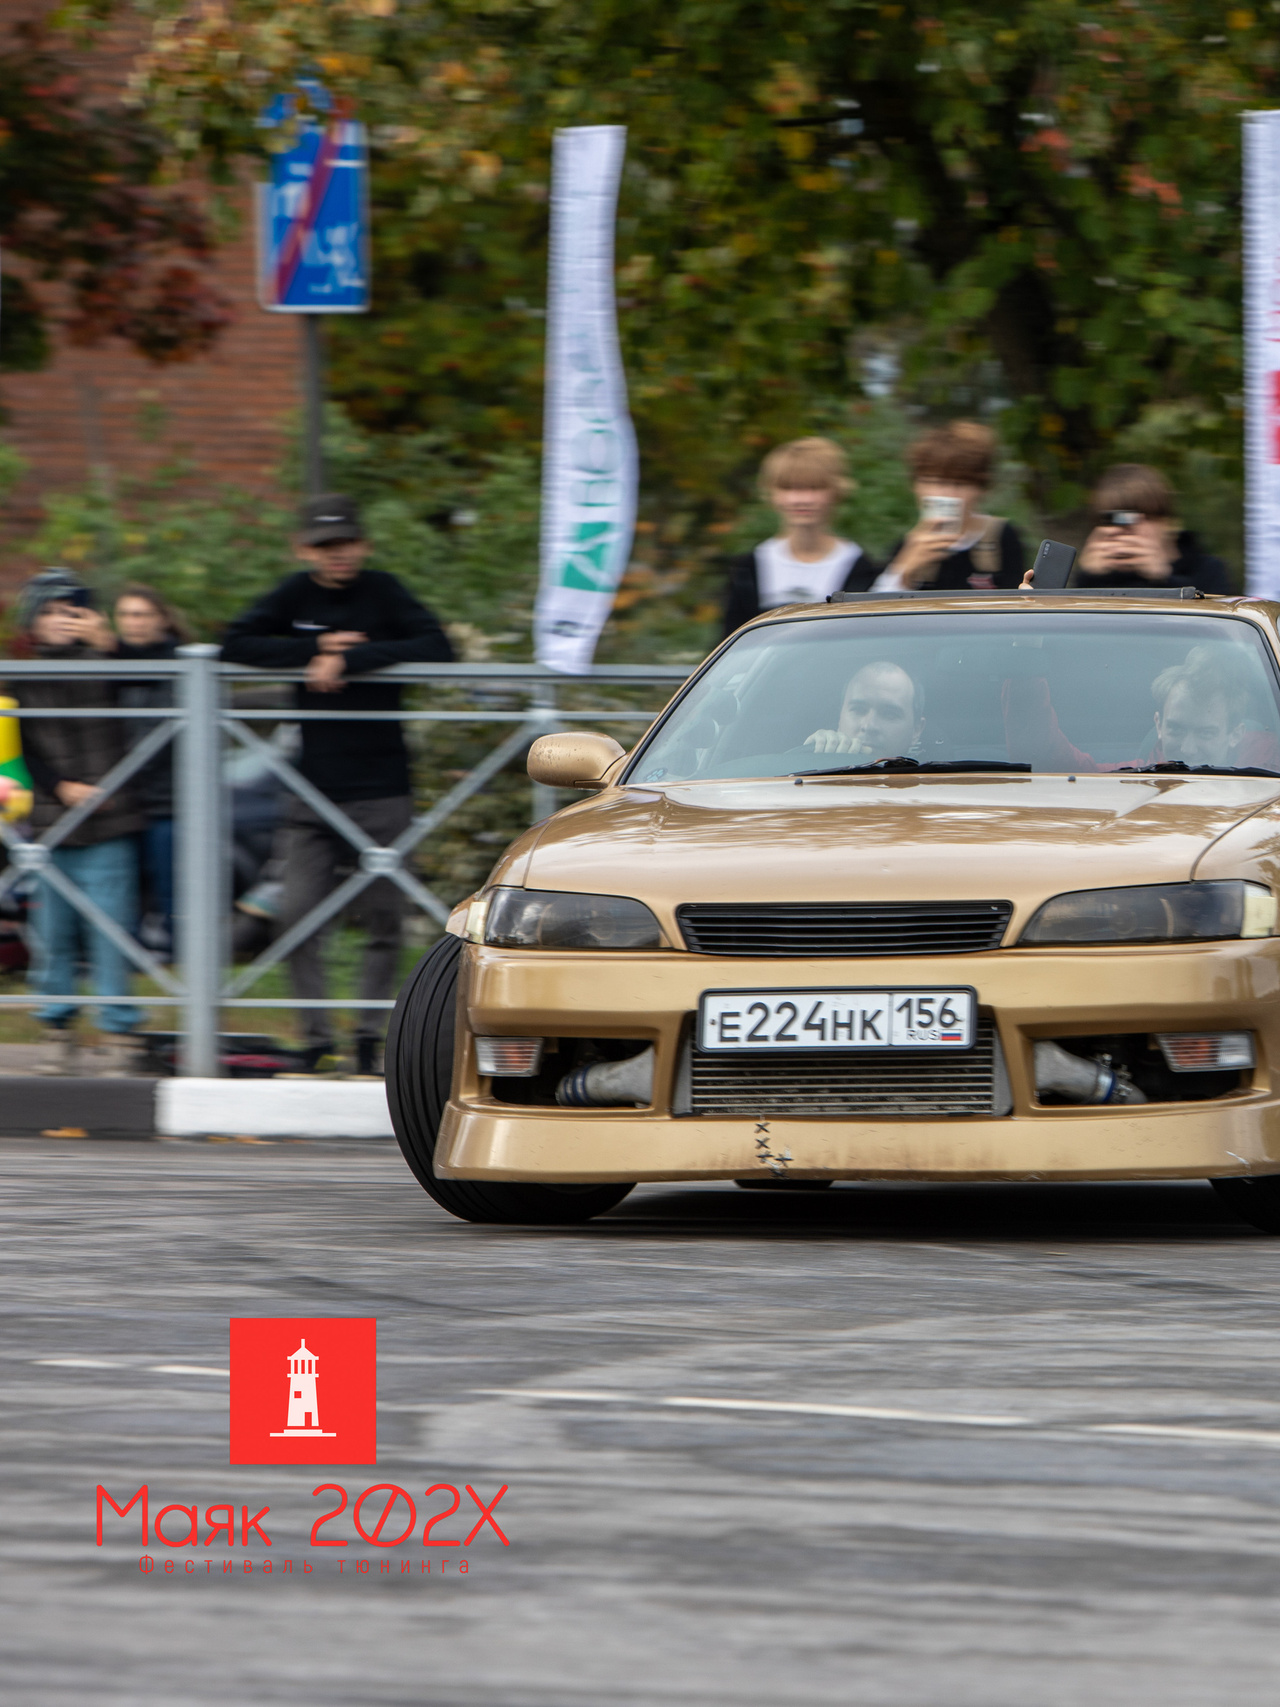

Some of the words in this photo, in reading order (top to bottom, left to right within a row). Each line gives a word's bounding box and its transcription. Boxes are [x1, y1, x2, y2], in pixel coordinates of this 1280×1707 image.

[718, 1000, 883, 1043] Е224НК
[895, 997, 957, 1029] 156
[906, 1029, 939, 1041] RUS
